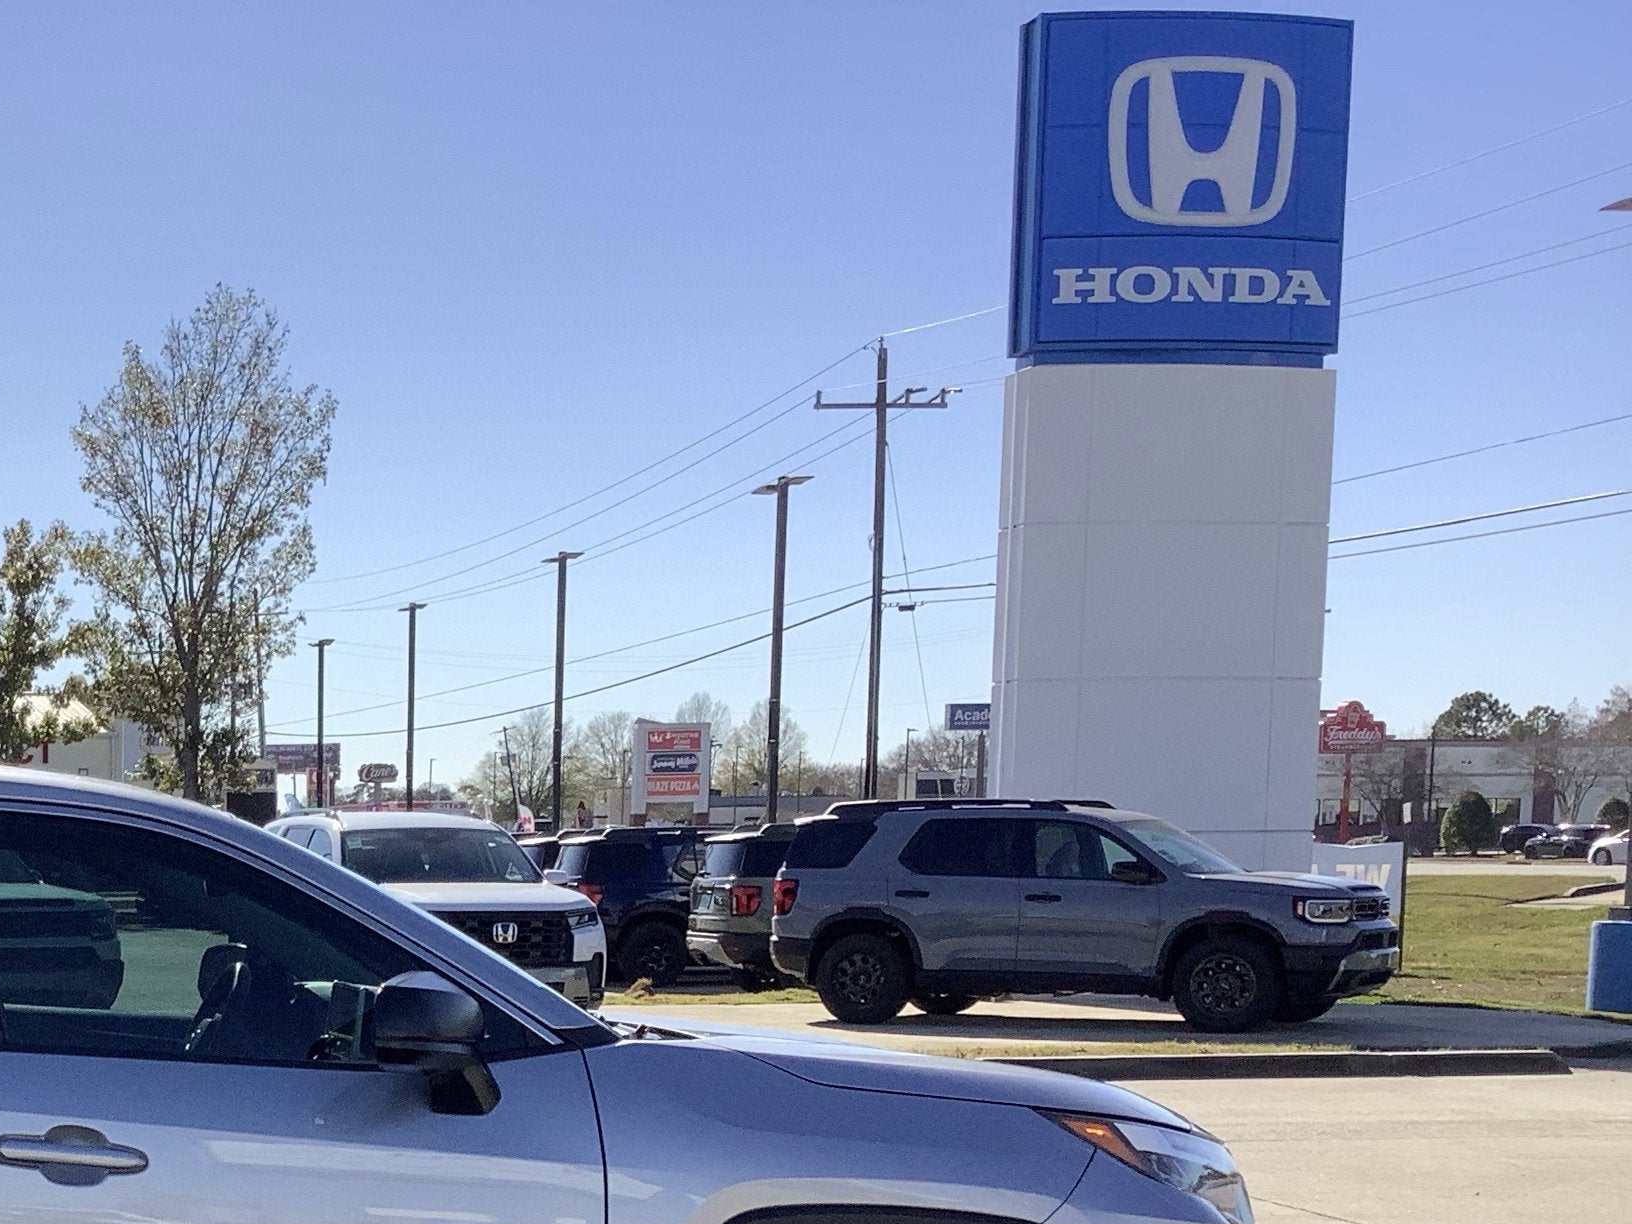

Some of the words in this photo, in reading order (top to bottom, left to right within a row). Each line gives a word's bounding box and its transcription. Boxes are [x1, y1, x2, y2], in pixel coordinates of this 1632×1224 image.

[1052, 265, 1330, 306] HONDA
[954, 709, 989, 721] Acad
[1325, 725, 1382, 742] Freddy's
